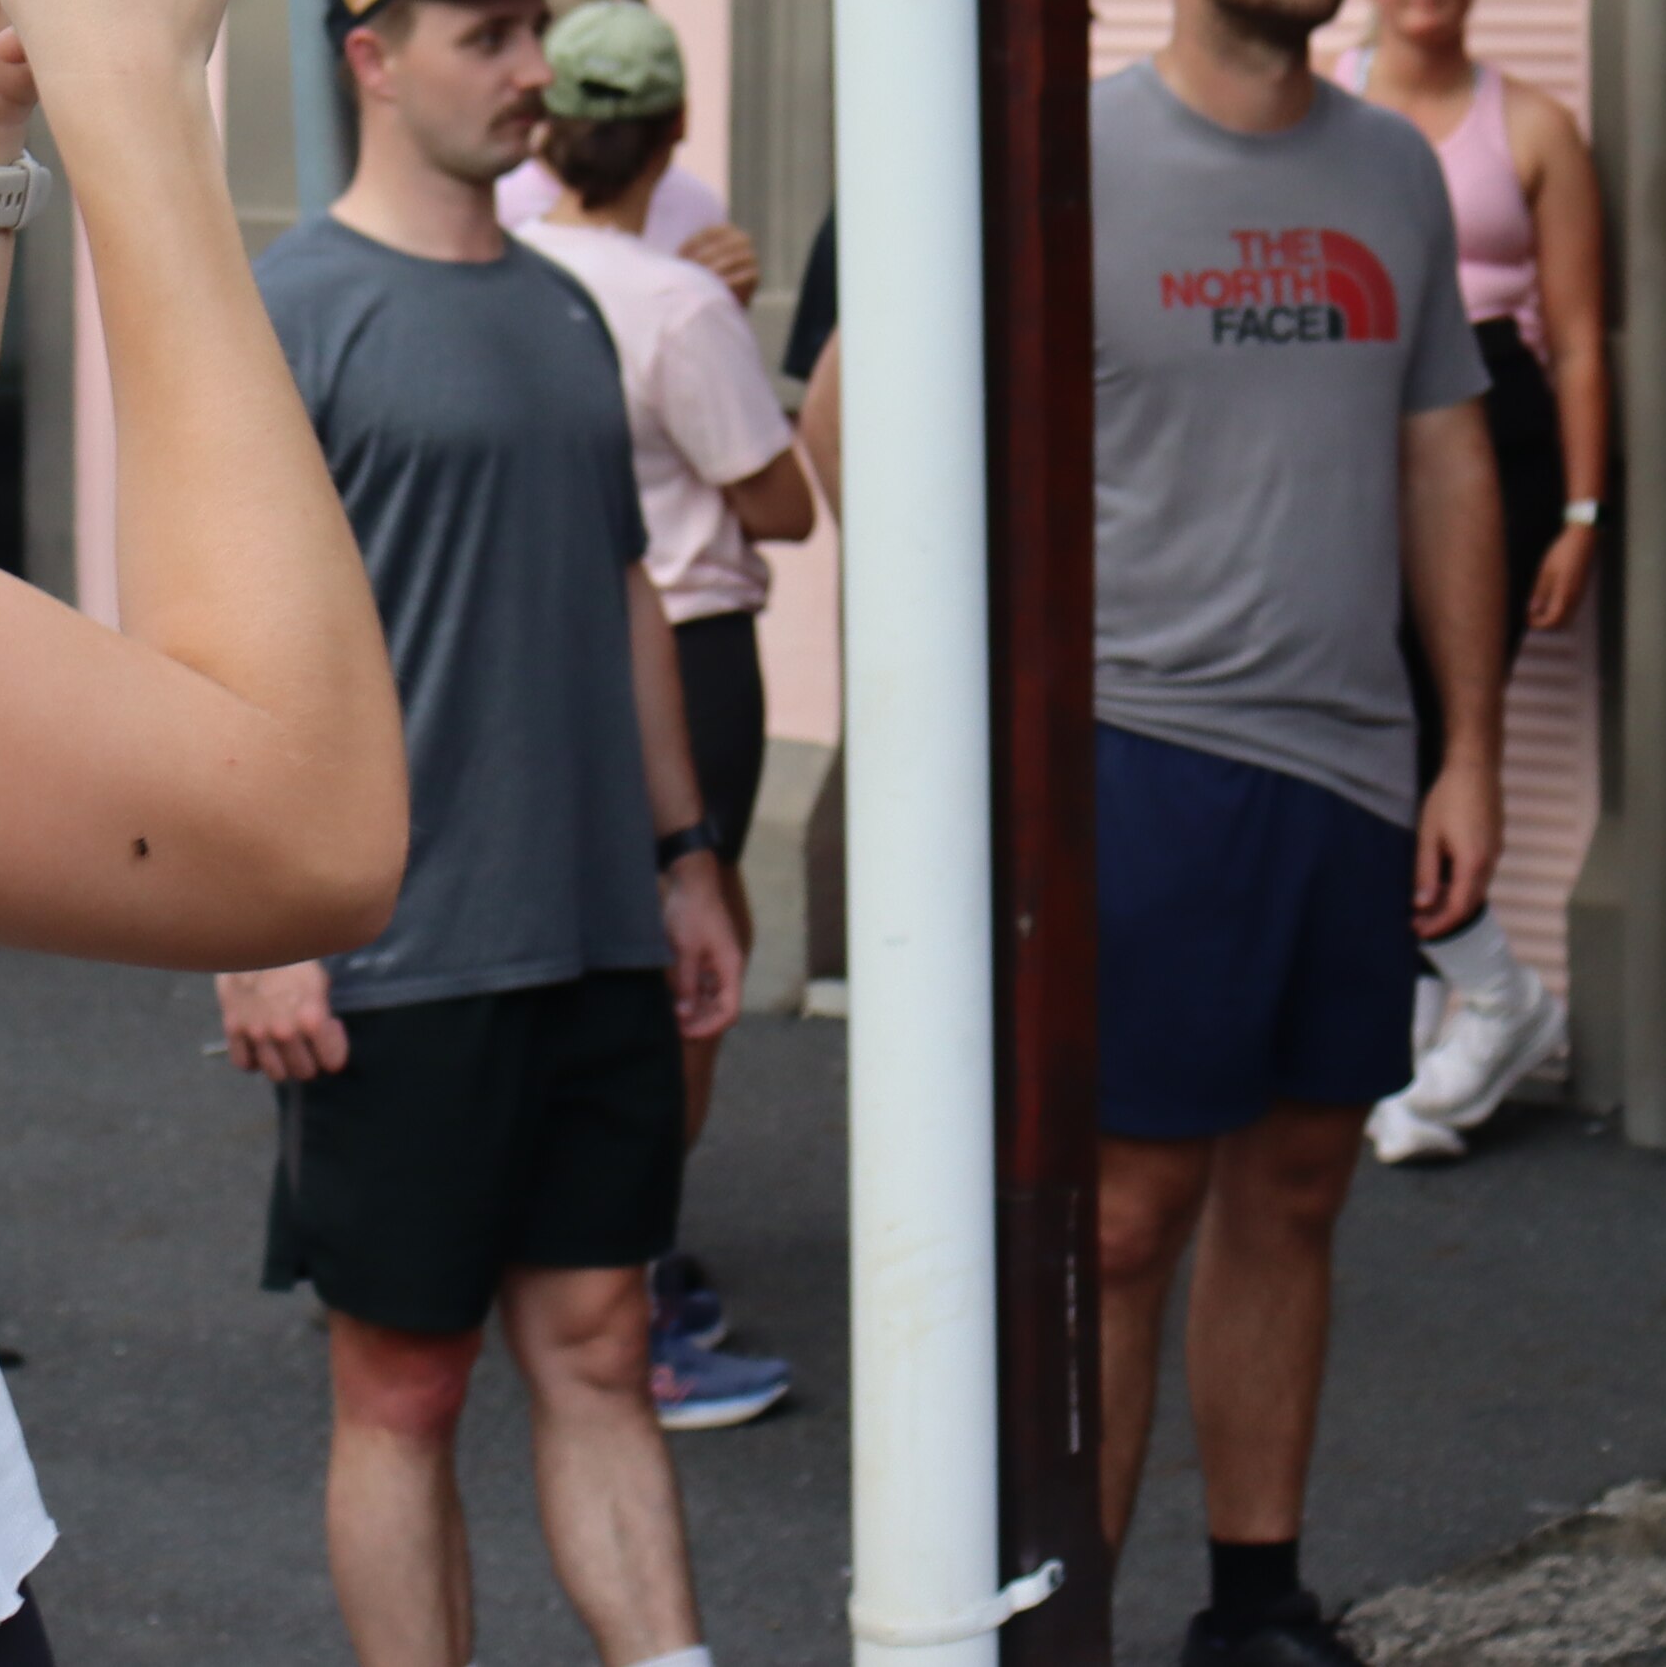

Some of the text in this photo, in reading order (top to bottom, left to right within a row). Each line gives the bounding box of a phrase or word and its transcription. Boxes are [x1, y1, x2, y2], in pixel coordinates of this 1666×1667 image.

[1231, 227, 1319, 269] THE
[1159, 267, 1324, 310] NORTH
[1212, 305, 1324, 344] FACE
